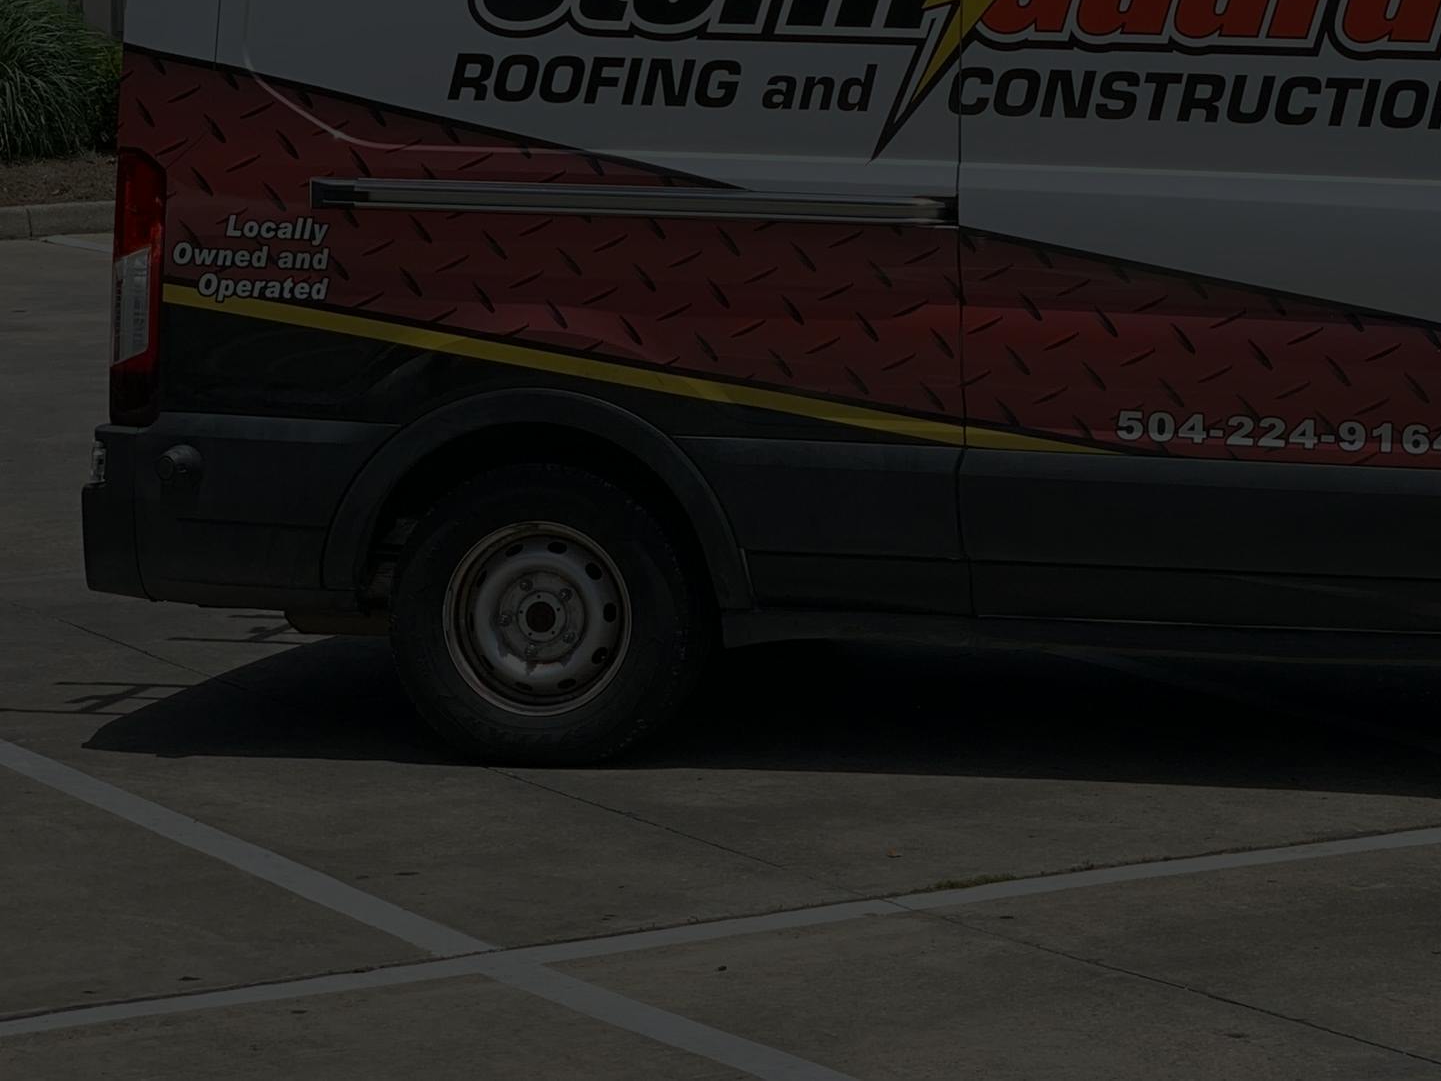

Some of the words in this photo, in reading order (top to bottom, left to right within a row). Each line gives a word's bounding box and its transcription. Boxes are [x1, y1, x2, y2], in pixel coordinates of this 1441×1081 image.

[447, 52, 742, 109] ROOFING
[762, 63, 878, 113] and
[225, 214, 330, 247] Locally
[172, 240, 270, 269] Owned
[276, 247, 330, 271] and
[198, 271, 330, 303] Operated
